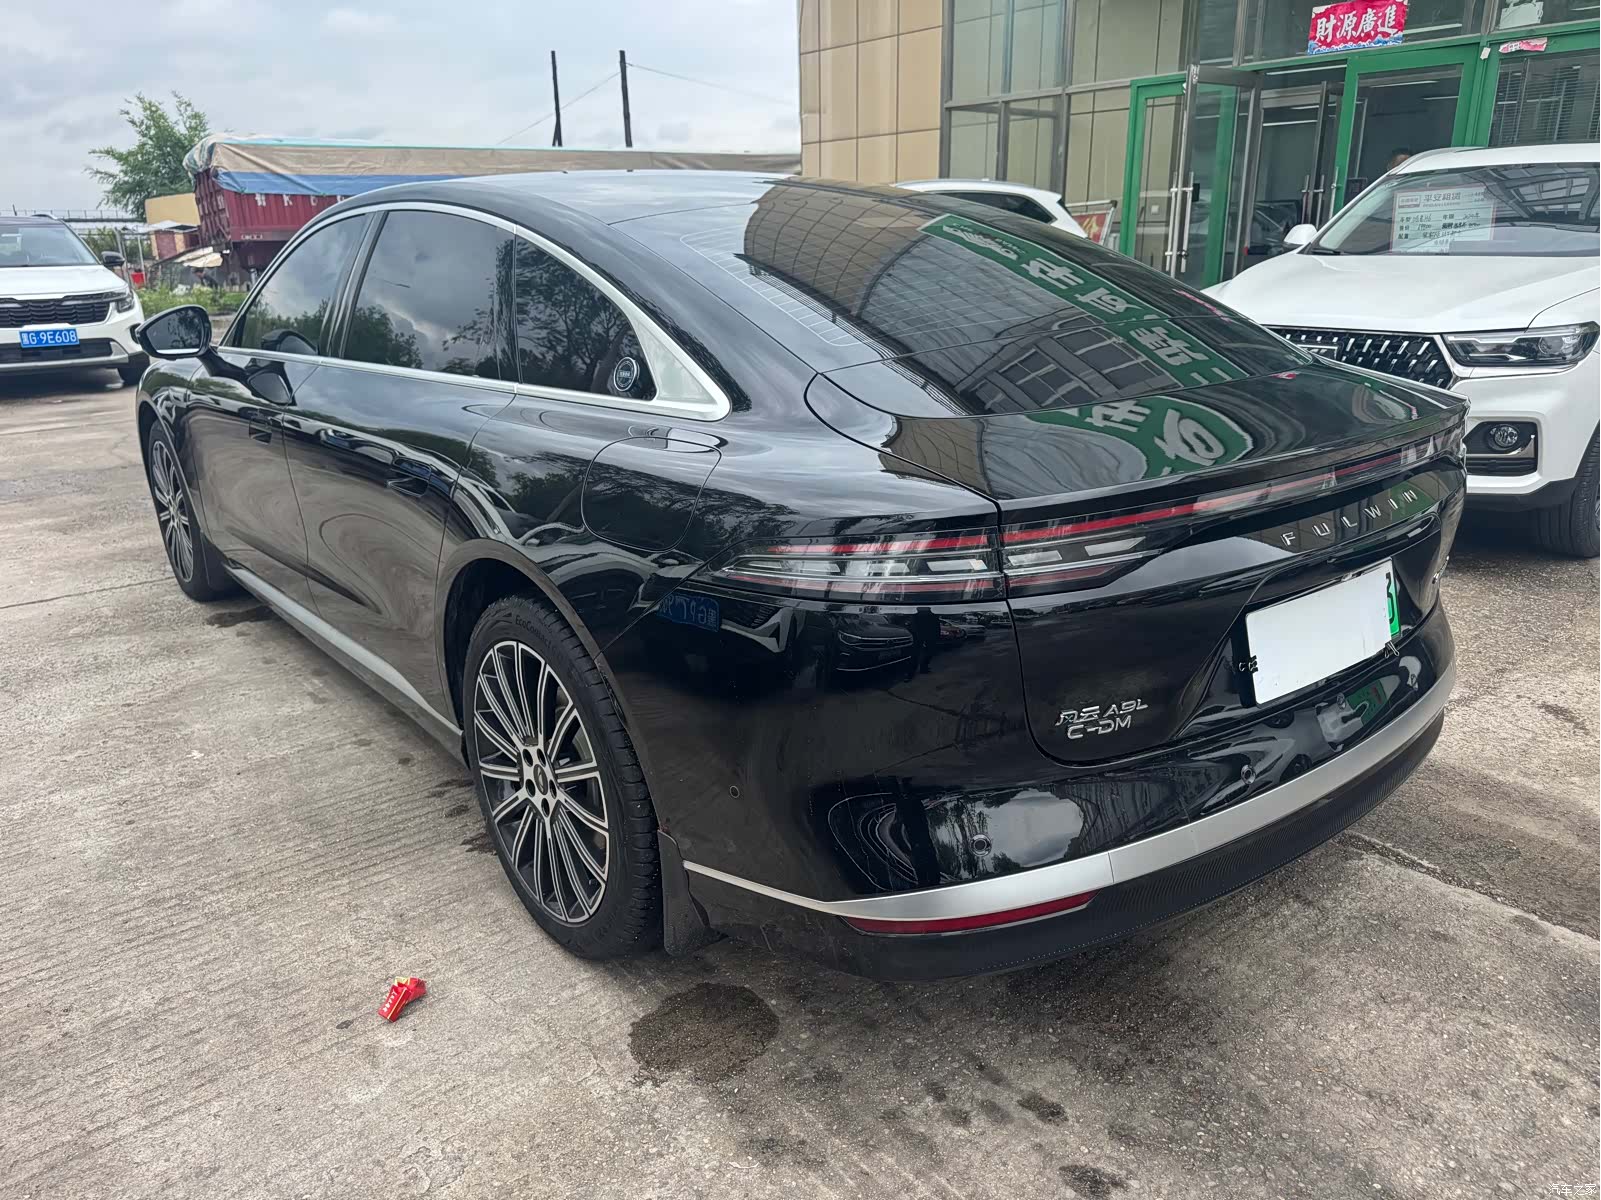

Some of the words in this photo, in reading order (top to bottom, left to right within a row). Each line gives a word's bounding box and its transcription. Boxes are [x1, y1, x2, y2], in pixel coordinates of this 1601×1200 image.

[1314, 9, 1398, 43] 財源廣進
[1281, 489, 1418, 546] FULWIN
[1055, 705, 1101, 726] 风云
[1104, 699, 1148, 717] A9L
[1067, 715, 1132, 740] C-DM
